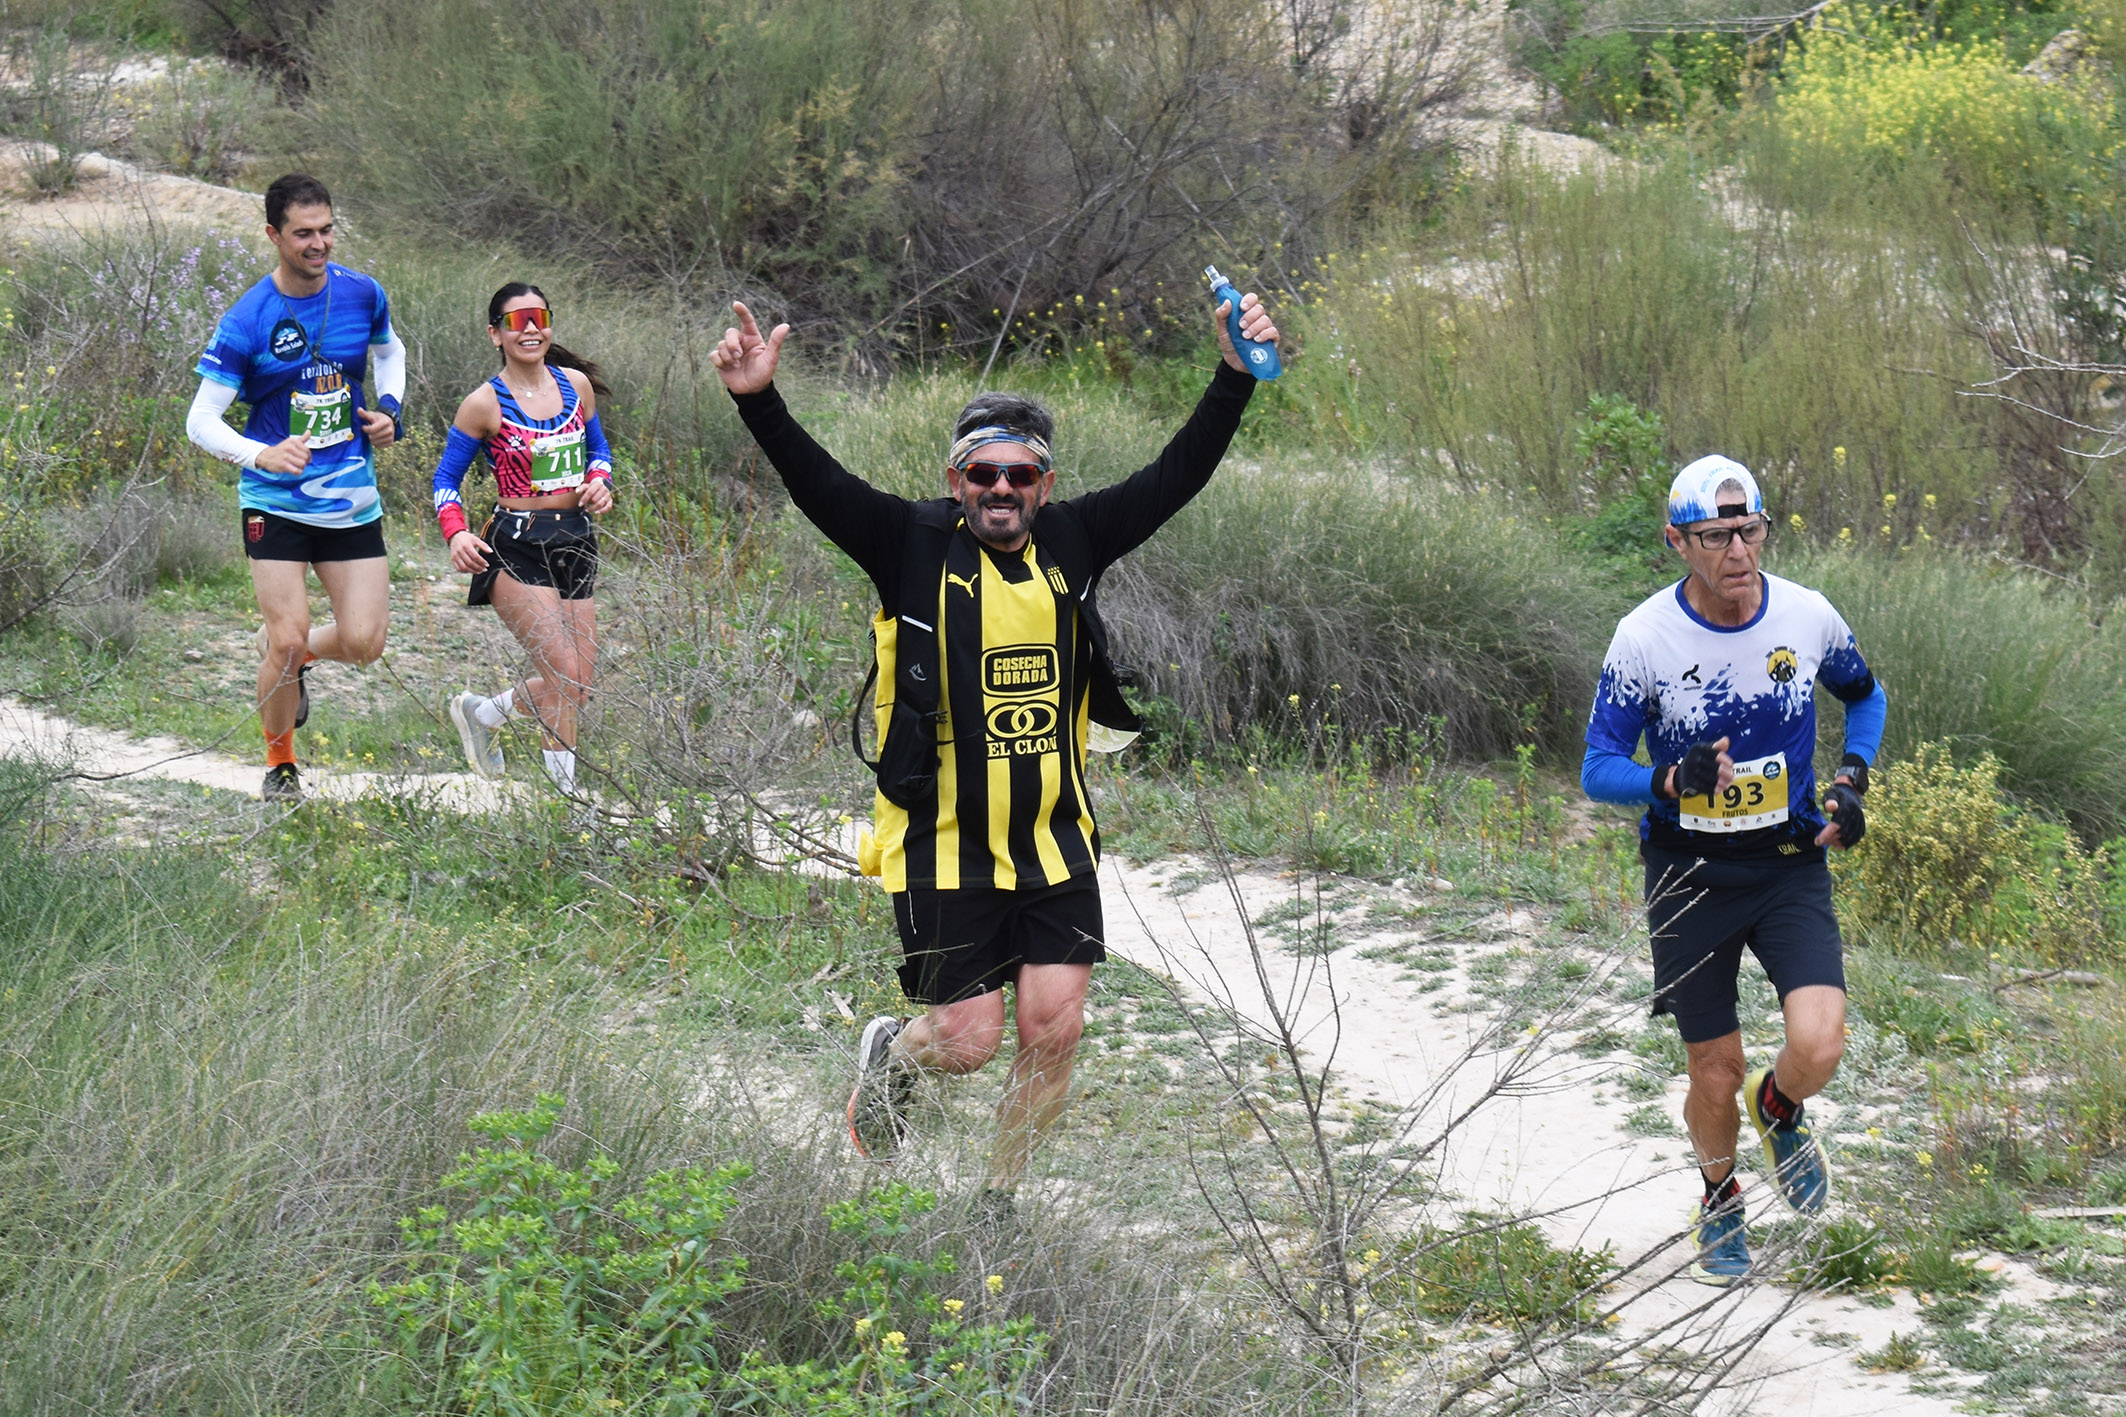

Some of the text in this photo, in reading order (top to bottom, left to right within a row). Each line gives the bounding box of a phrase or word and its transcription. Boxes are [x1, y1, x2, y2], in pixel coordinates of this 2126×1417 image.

[305, 407, 342, 430] 734
[548, 447, 582, 472] 711
[993, 655, 1047, 672] COSECHA
[993, 668, 1048, 686] DORADA
[987, 736, 1057, 758] EL CLON
[1722, 808, 1748, 818] FRUTOS
